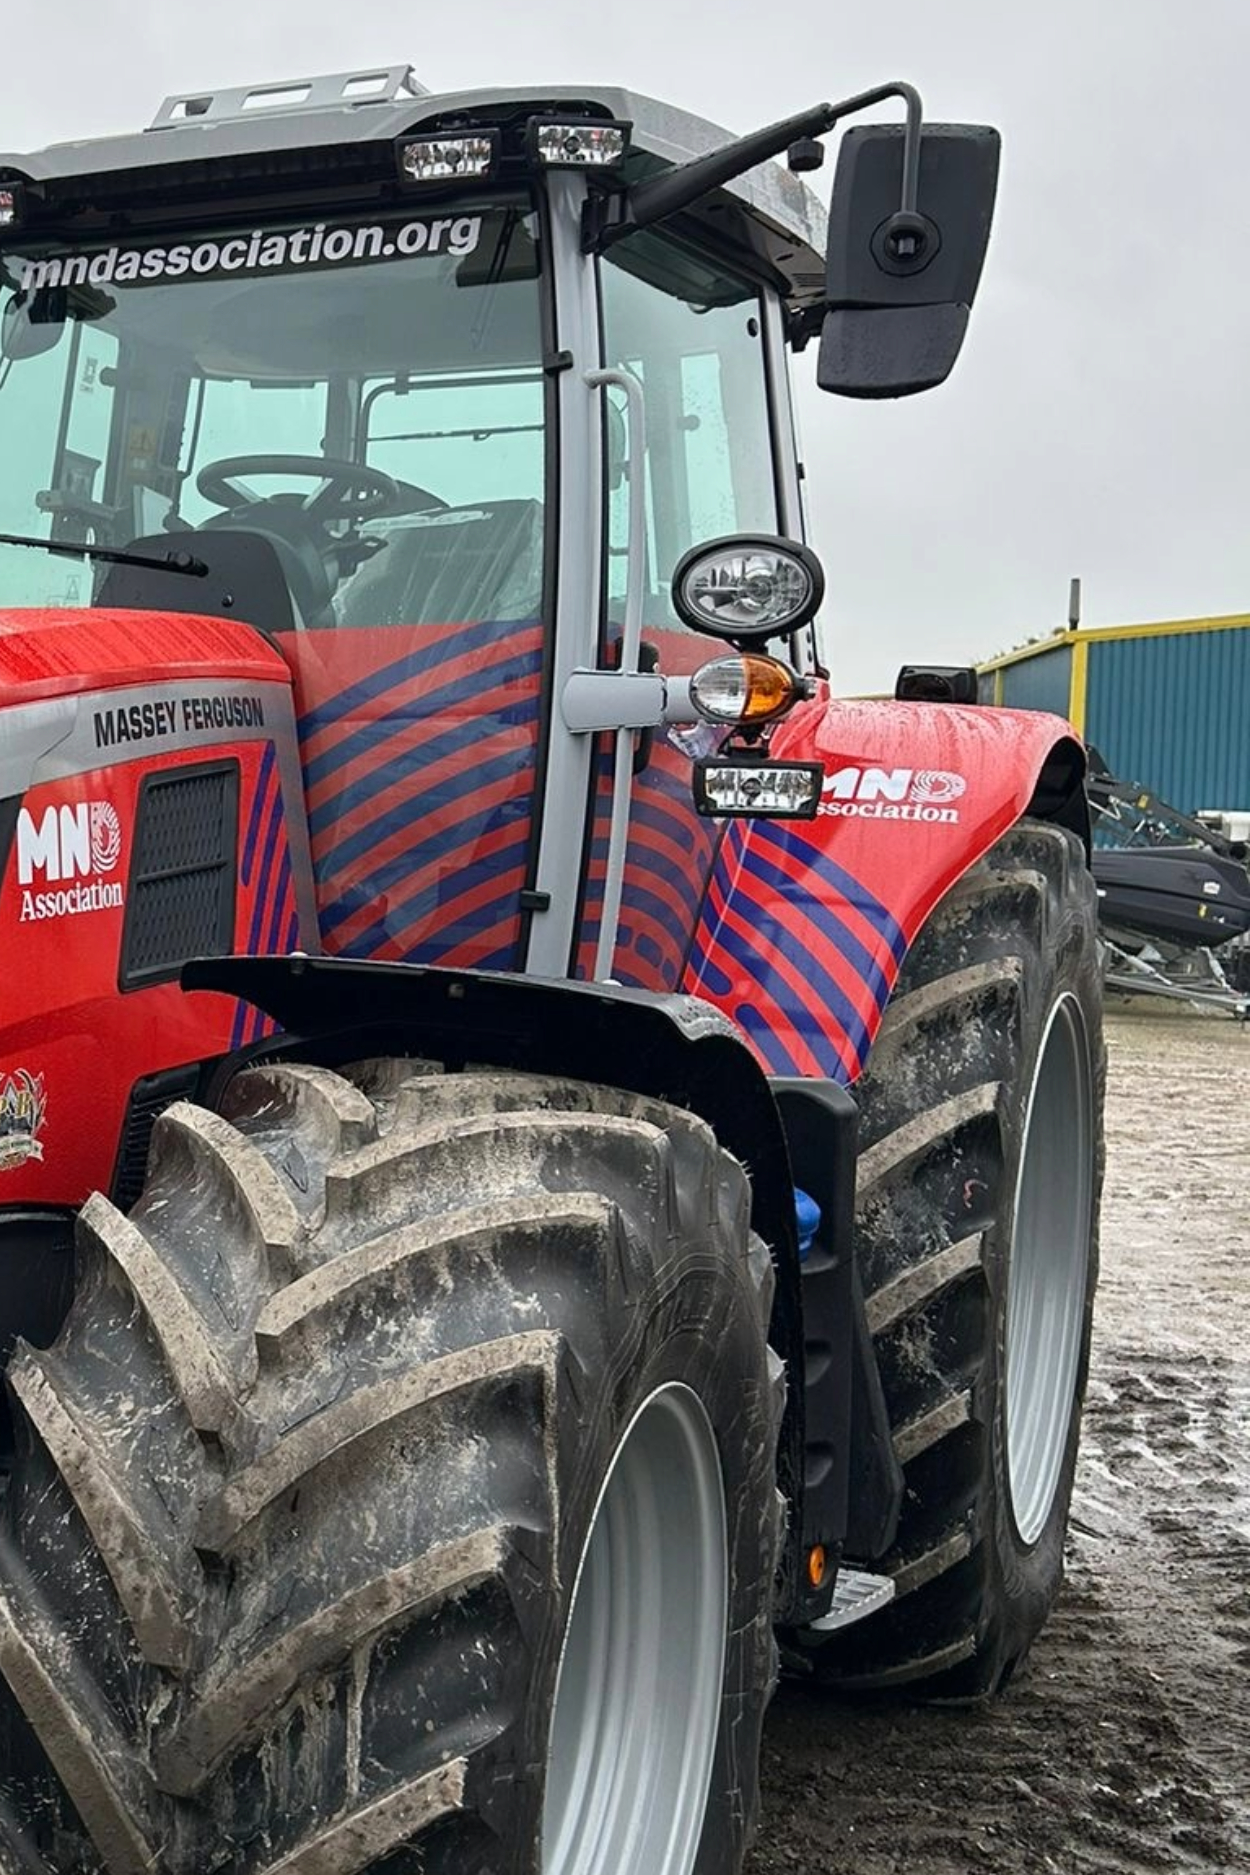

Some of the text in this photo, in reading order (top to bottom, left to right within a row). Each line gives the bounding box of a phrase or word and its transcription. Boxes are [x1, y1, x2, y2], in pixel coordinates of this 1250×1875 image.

[22, 216, 481, 290] mndassociation.org
[94, 696, 265, 747] MASSEY FERGUSON
[16, 801, 121, 885] MND
[19, 881, 123, 922] Association
